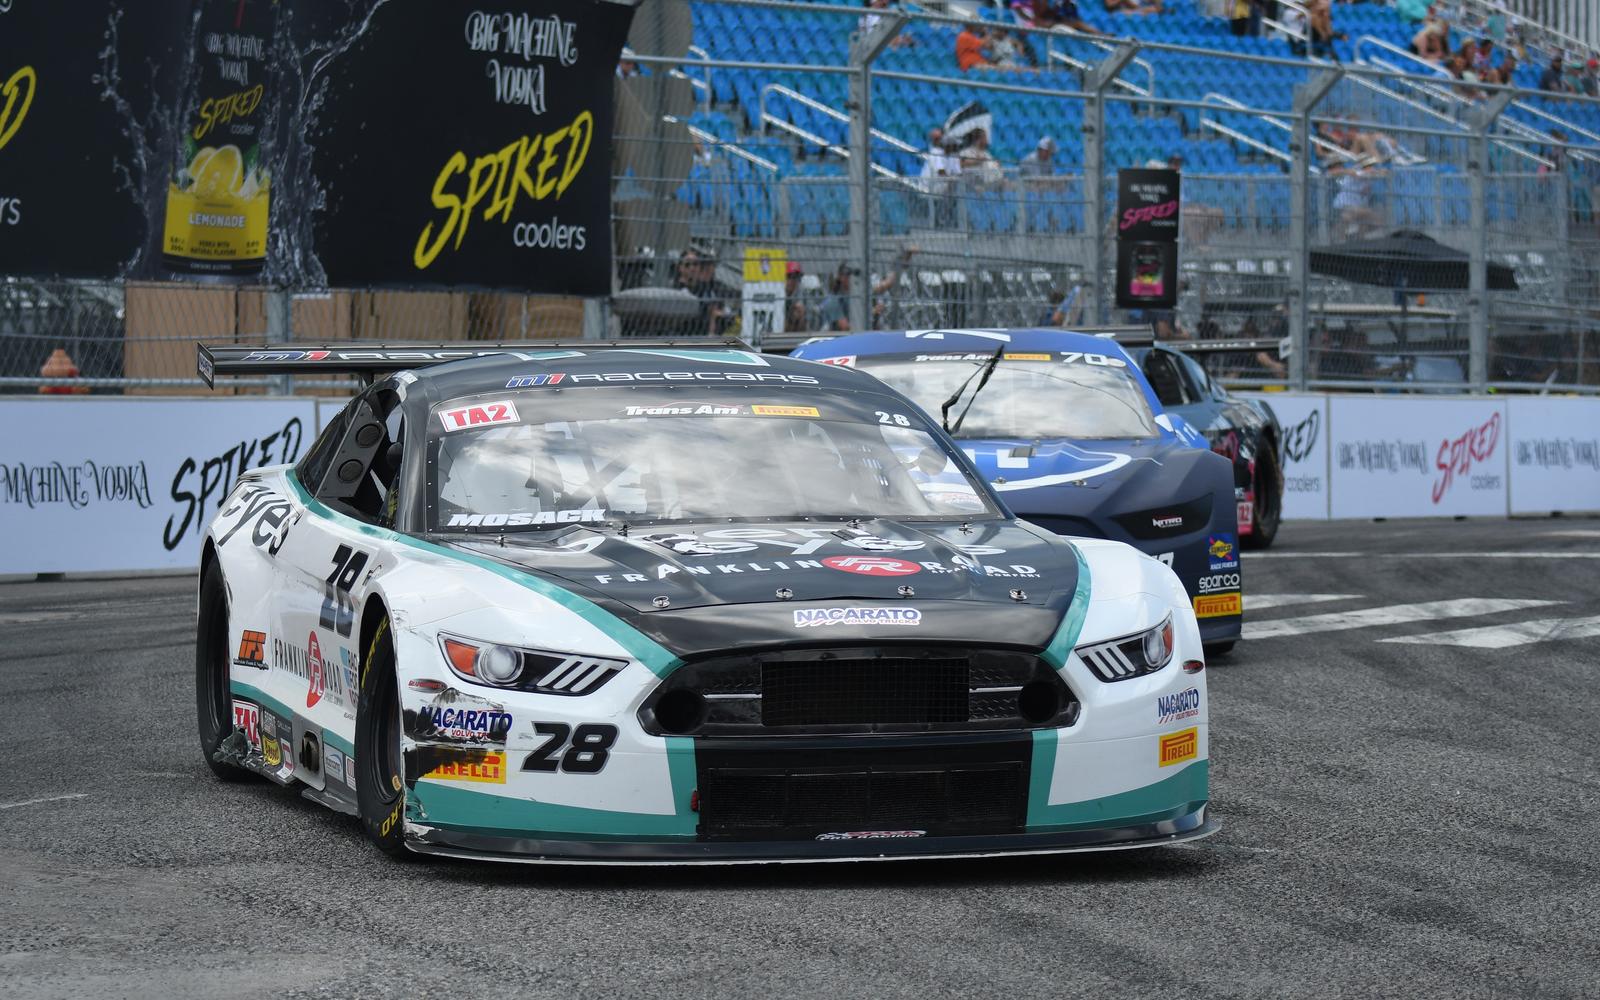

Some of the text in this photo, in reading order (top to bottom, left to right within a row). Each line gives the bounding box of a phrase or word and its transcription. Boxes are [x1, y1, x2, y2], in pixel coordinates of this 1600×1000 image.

[465, 11, 578, 67] BIG MACHINE
[486, 59, 546, 115] VODKA
[193, 84, 264, 139] SPIKED
[414, 110, 593, 269] SPIKED
[189, 213, 246, 229] LEMONADE
[513, 217, 586, 250] coolers
[448, 405, 510, 427] TA2
[625, 405, 739, 416] Trans Am
[875, 411, 910, 426] 28
[1282, 409, 1319, 469] KED
[1433, 412, 1501, 504] SPIKED
[0, 459, 154, 509] MACHINE VODKA
[447, 508, 606, 527] MOSACK
[595, 559, 823, 585] FRANKLIN
[918, 555, 1036, 576] ROAD
[1199, 573, 1240, 594] sparco
[796, 608, 921, 621] NACARATO
[1197, 595, 1238, 614] PIRELLI
[274, 638, 310, 681] FRANKLIN
[1158, 688, 1199, 717] NACARATO
[520, 721, 620, 775] 28
[1161, 732, 1195, 762] PIRELLI
[432, 755, 500, 779] IRELLI
